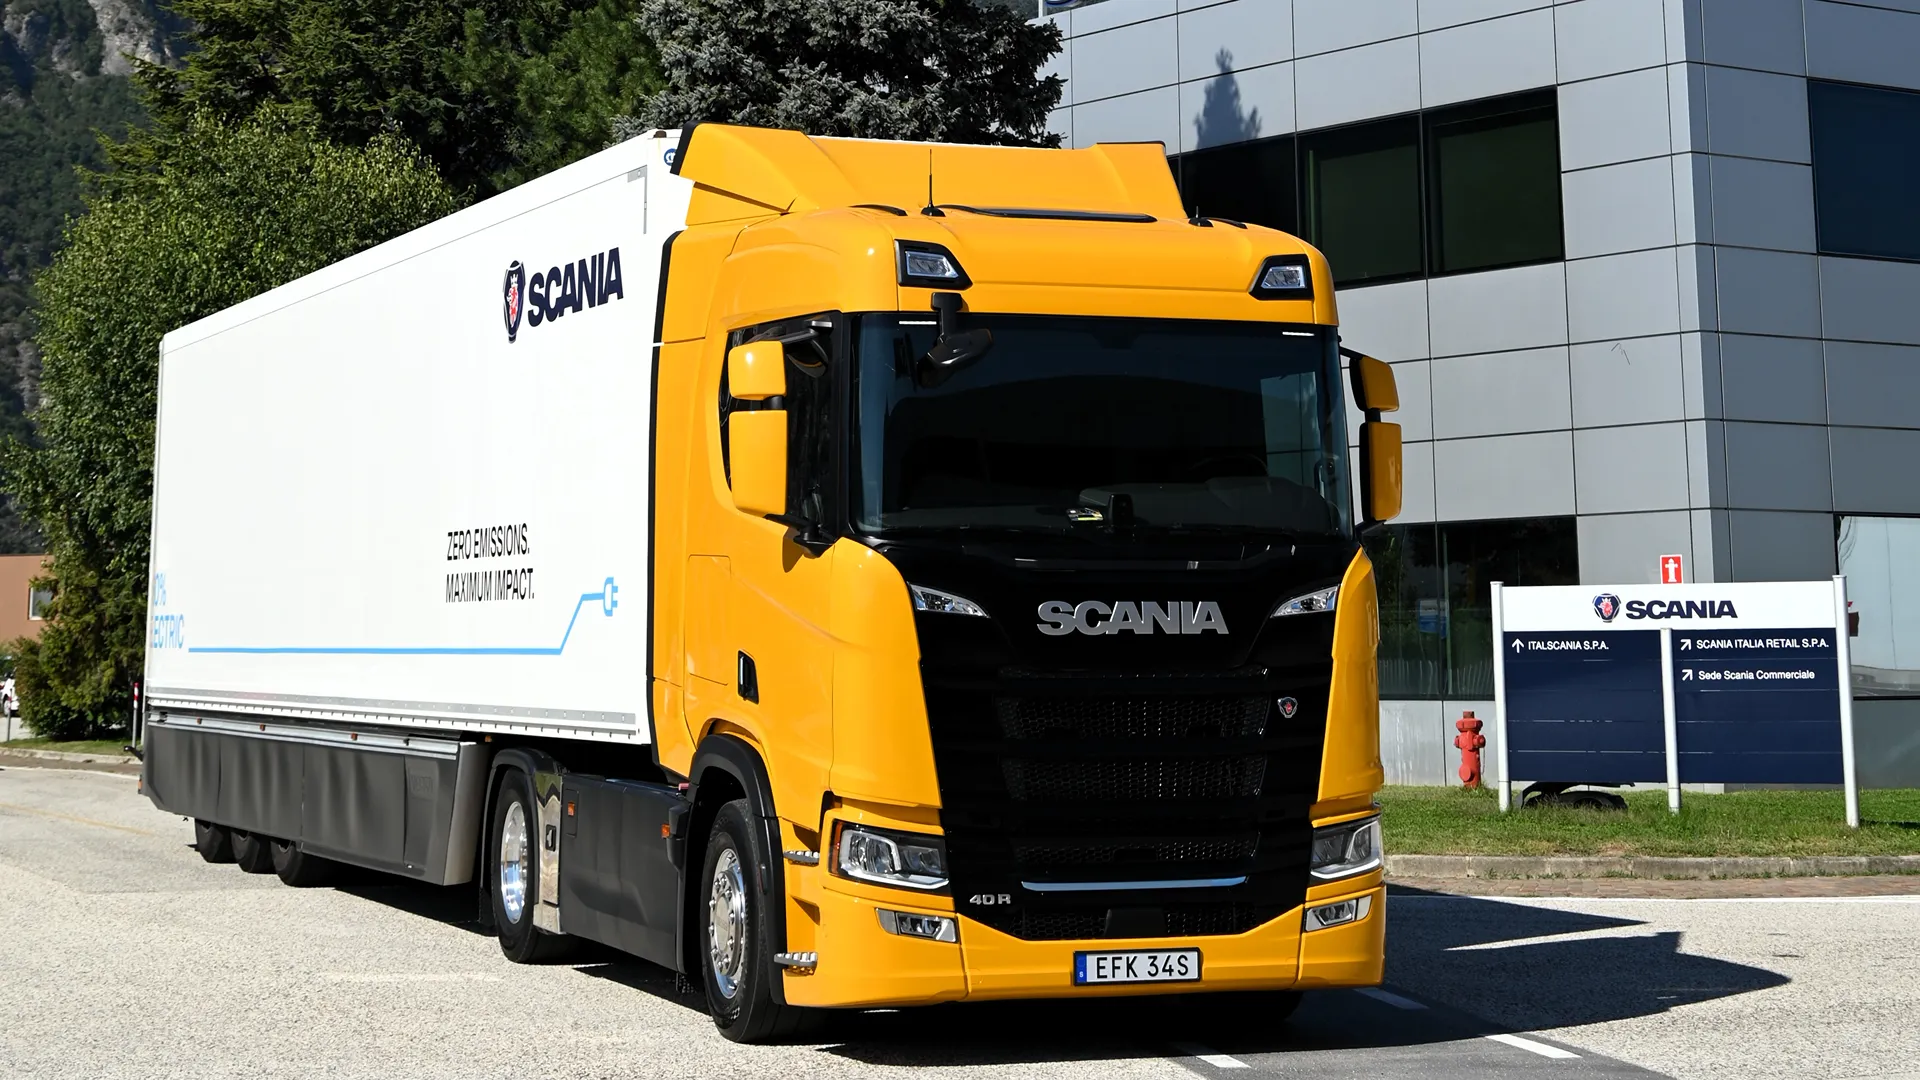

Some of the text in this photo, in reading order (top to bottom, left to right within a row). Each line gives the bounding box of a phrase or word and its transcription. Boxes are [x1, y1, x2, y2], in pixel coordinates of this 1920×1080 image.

[527, 247, 624, 327] SCANIA
[447, 523, 530, 560] ZERO EMISSIONS.
[446, 567, 535, 603] MAXIMUM IMPACT.
[1037, 600, 1229, 636] SCANIA
[1625, 600, 1738, 619] SCANIA
[1528, 640, 1609, 650] ITALSCANIA S.P.A.
[1696, 638, 1829, 649] SCANIA ITALIA RETAIL S.P.A.
[1698, 669, 1815, 680] Sede Scania Commerciale
[969, 893, 1011, 905] 40 R
[1096, 954, 1189, 979] EFK 34S
